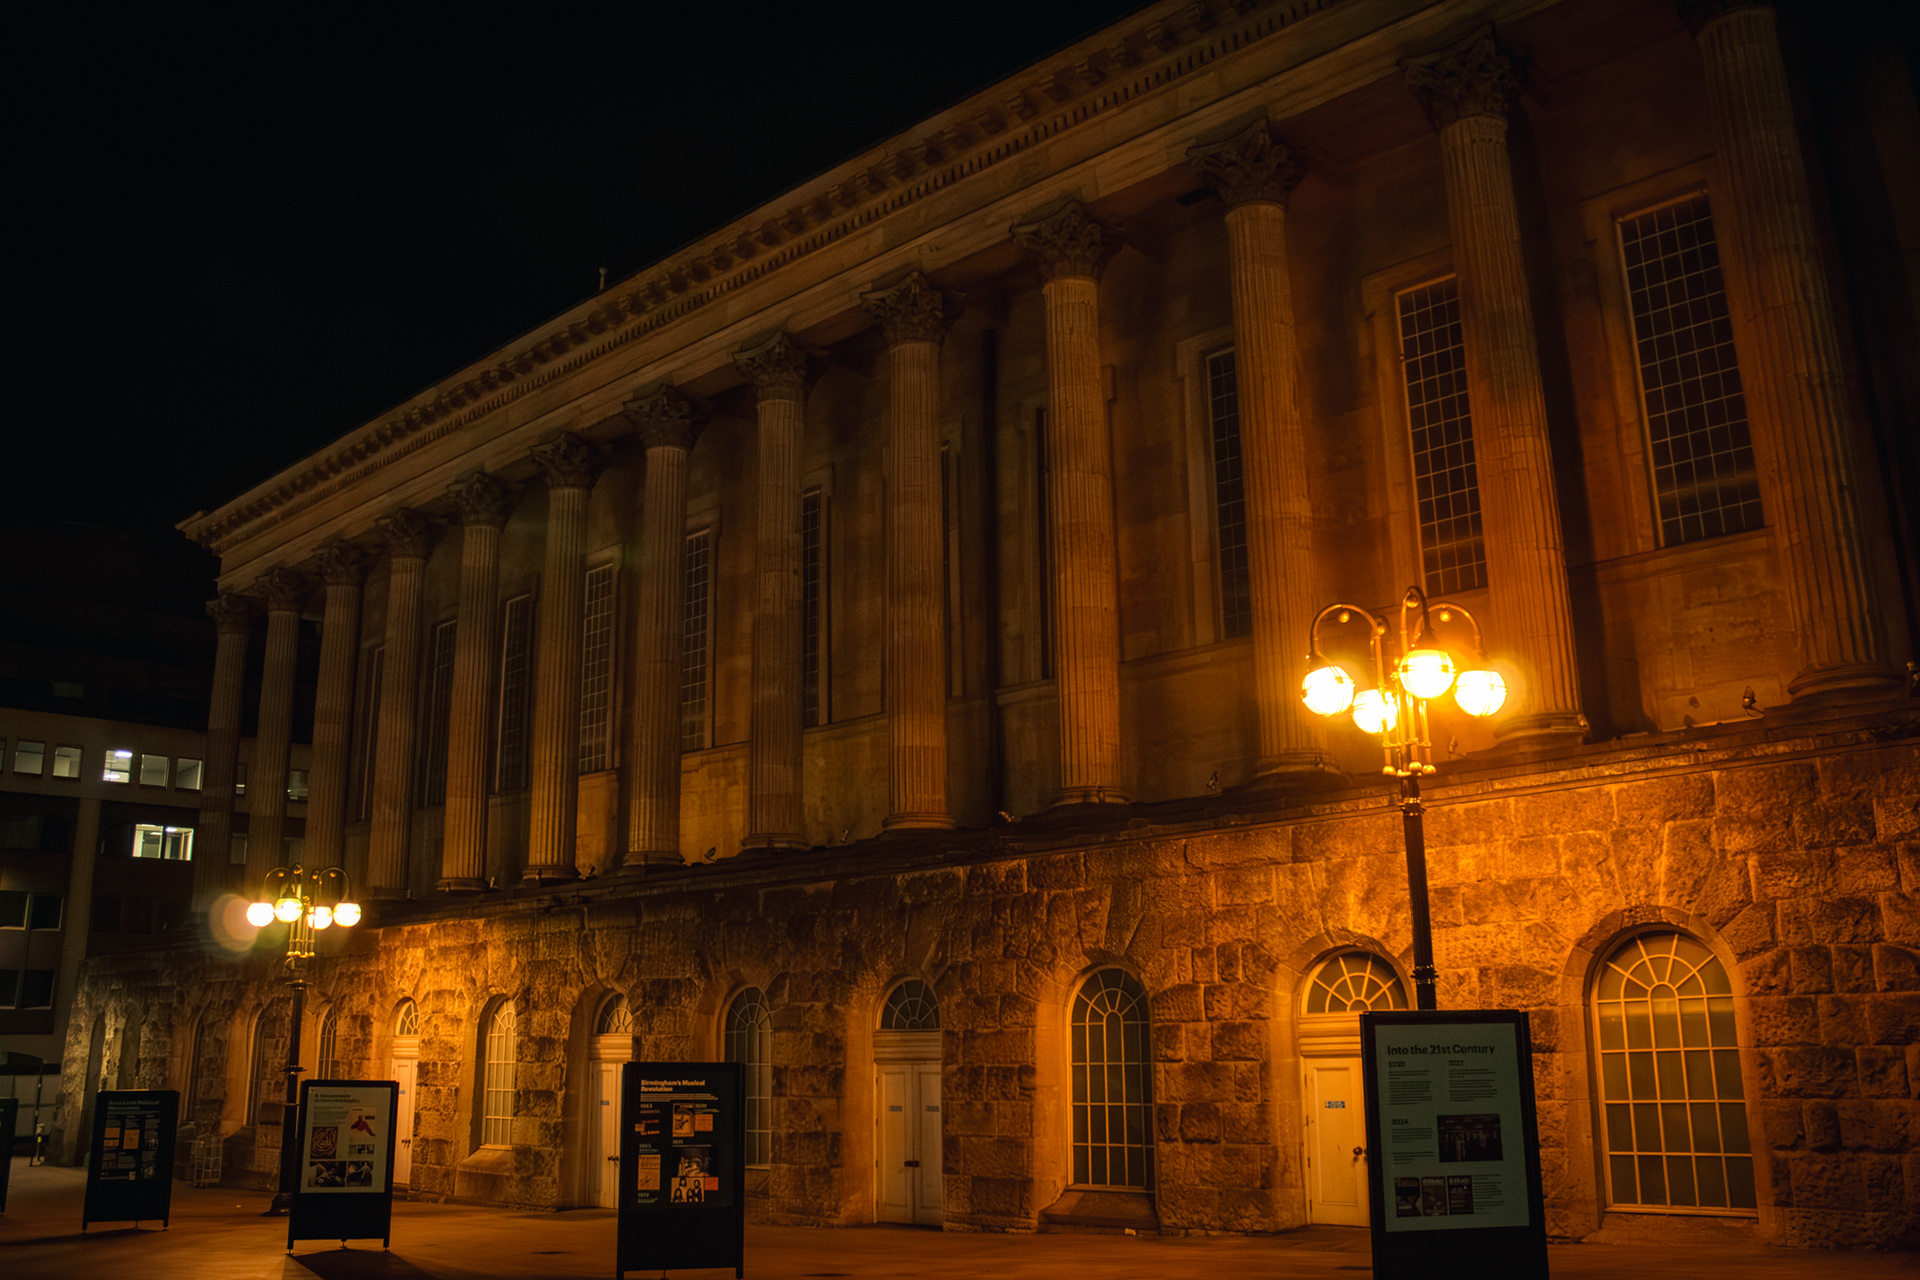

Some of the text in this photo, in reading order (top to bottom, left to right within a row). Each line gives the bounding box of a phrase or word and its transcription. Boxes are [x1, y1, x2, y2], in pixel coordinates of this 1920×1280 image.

[1388, 1043, 1495, 1055] Into the 21st Century
